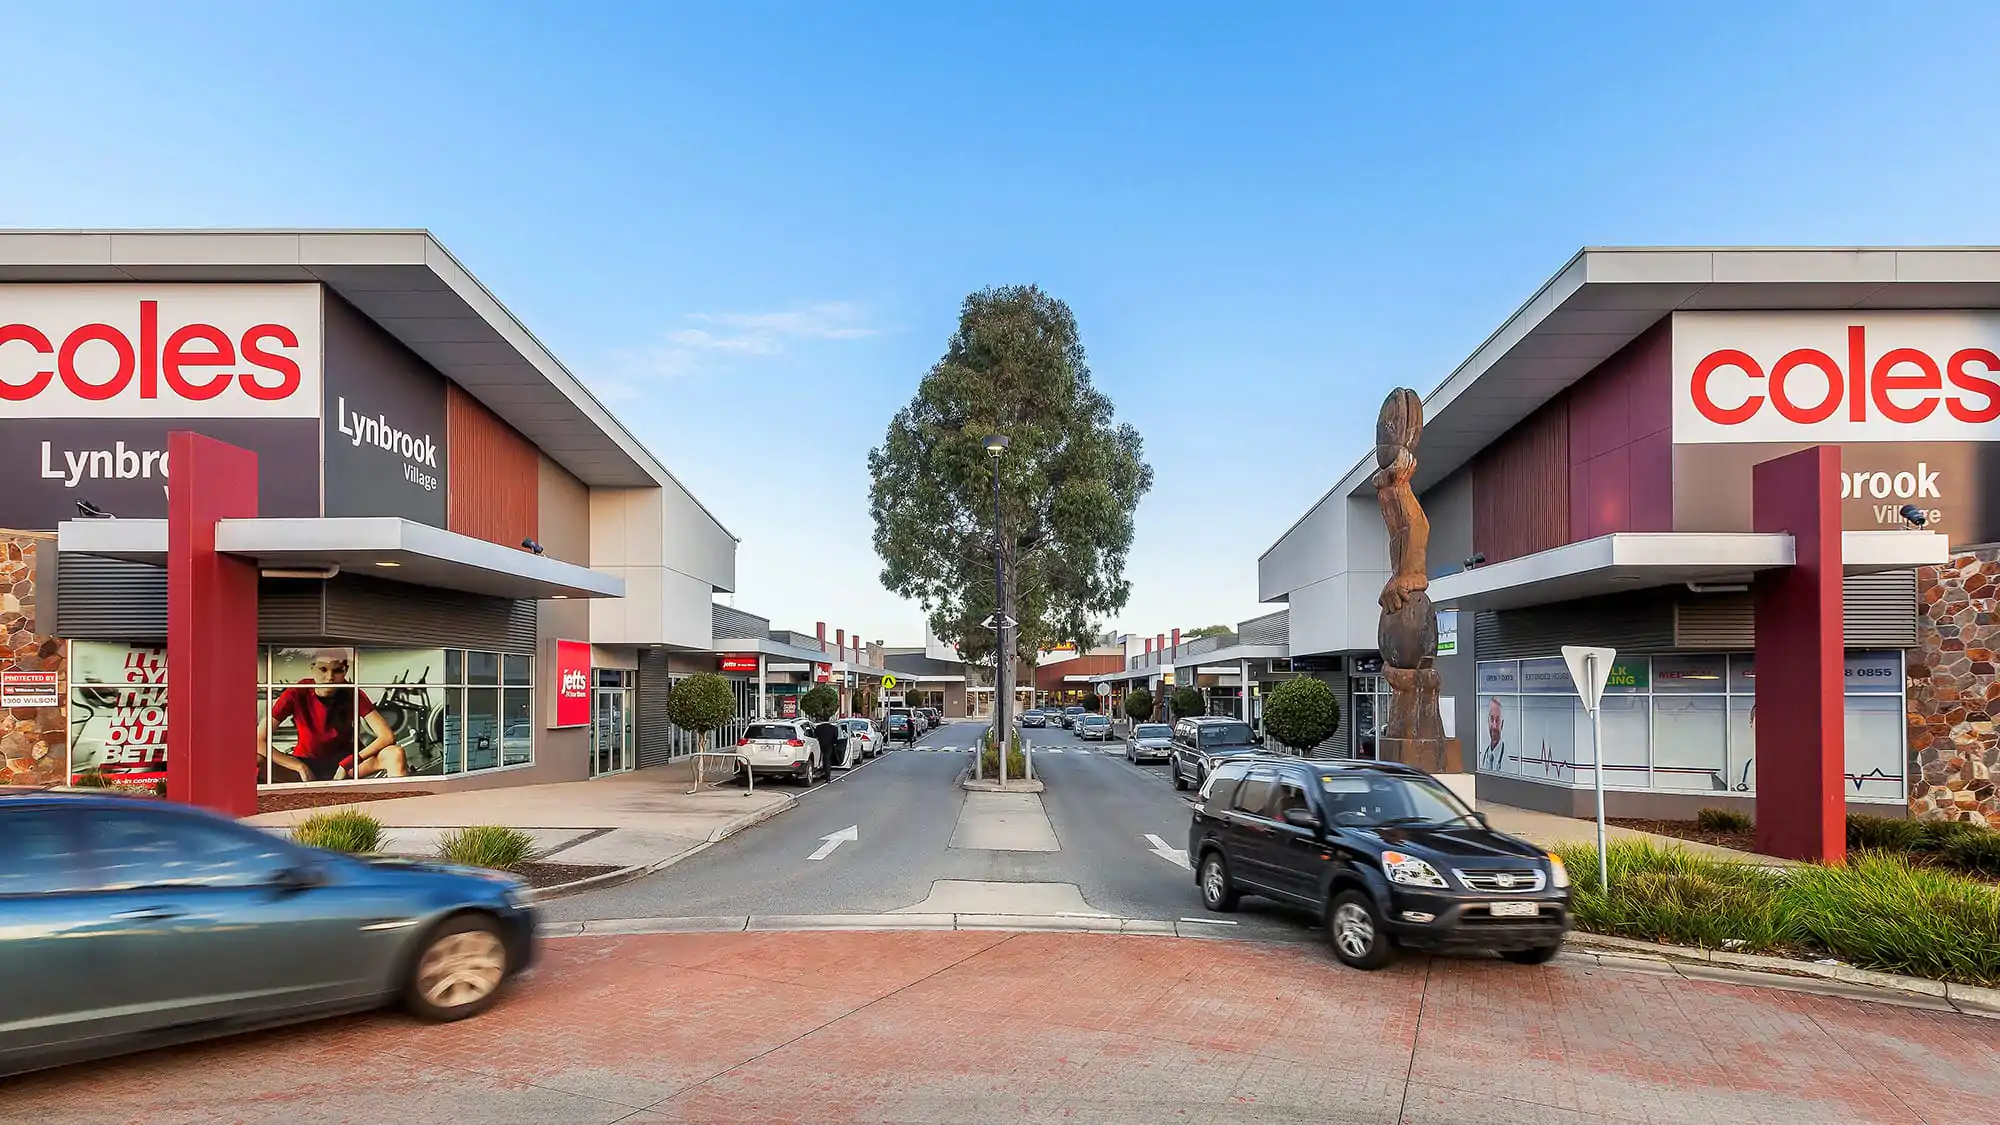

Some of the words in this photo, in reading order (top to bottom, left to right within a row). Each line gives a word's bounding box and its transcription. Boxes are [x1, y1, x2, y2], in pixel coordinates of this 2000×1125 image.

[0, 300, 301, 401] coles
[1690, 325, 2000, 425] coles
[338, 396, 437, 469] Lynbrook
[403, 462, 437, 491] Village
[125, 668, 168, 684] GY
[561, 668, 587, 695] jetts
[1857, 668, 1892, 677] 0855
[112, 707, 168, 726] WO
[102, 745, 168, 763] BET
